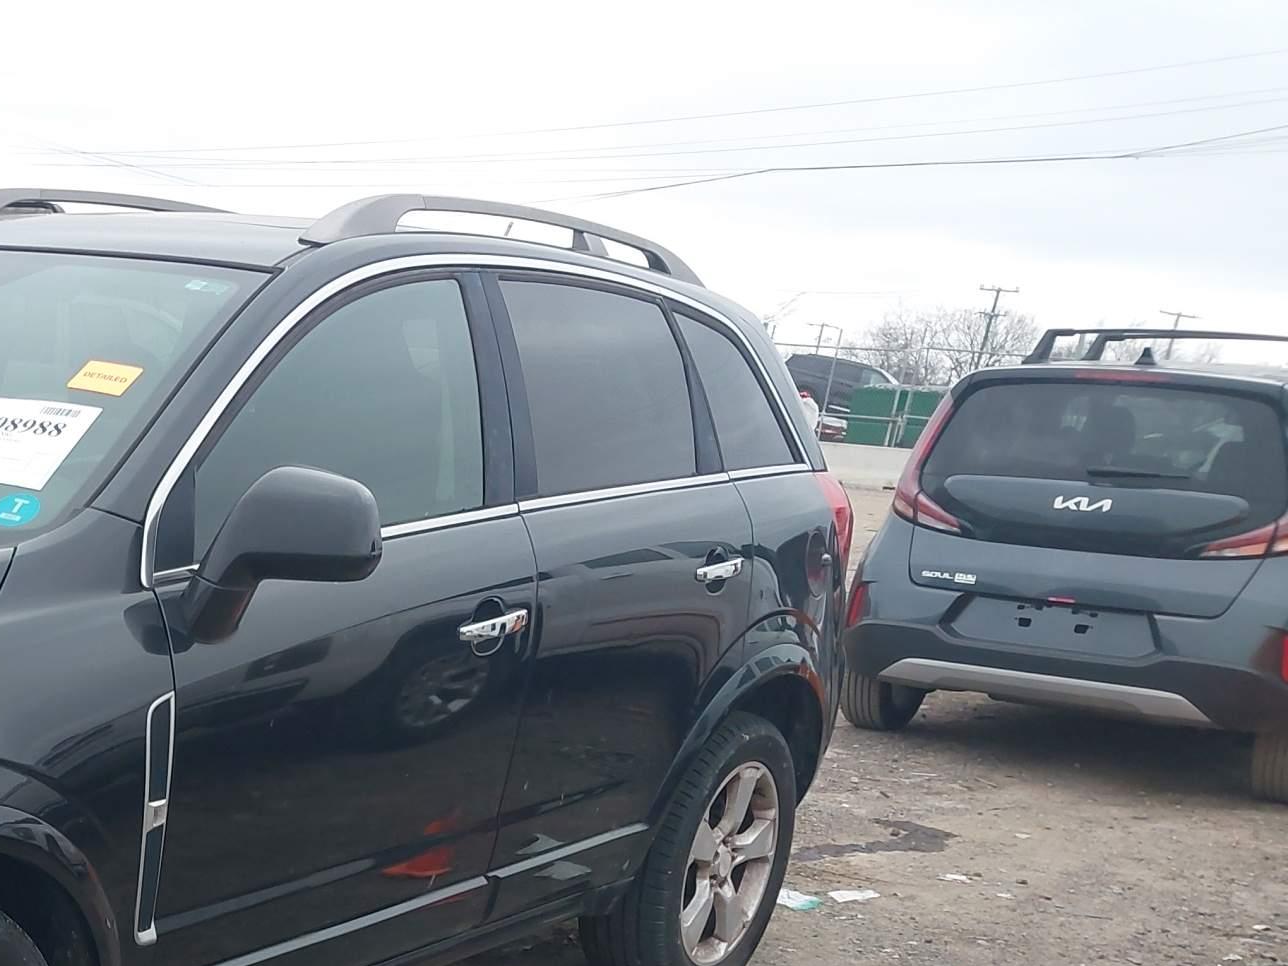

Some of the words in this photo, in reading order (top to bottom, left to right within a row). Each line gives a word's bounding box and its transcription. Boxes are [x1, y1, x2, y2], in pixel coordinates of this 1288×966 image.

[82, 371, 128, 384] DETAILED
[12, 497, 30, 513] T
[920, 570, 954, 580] SOUL
